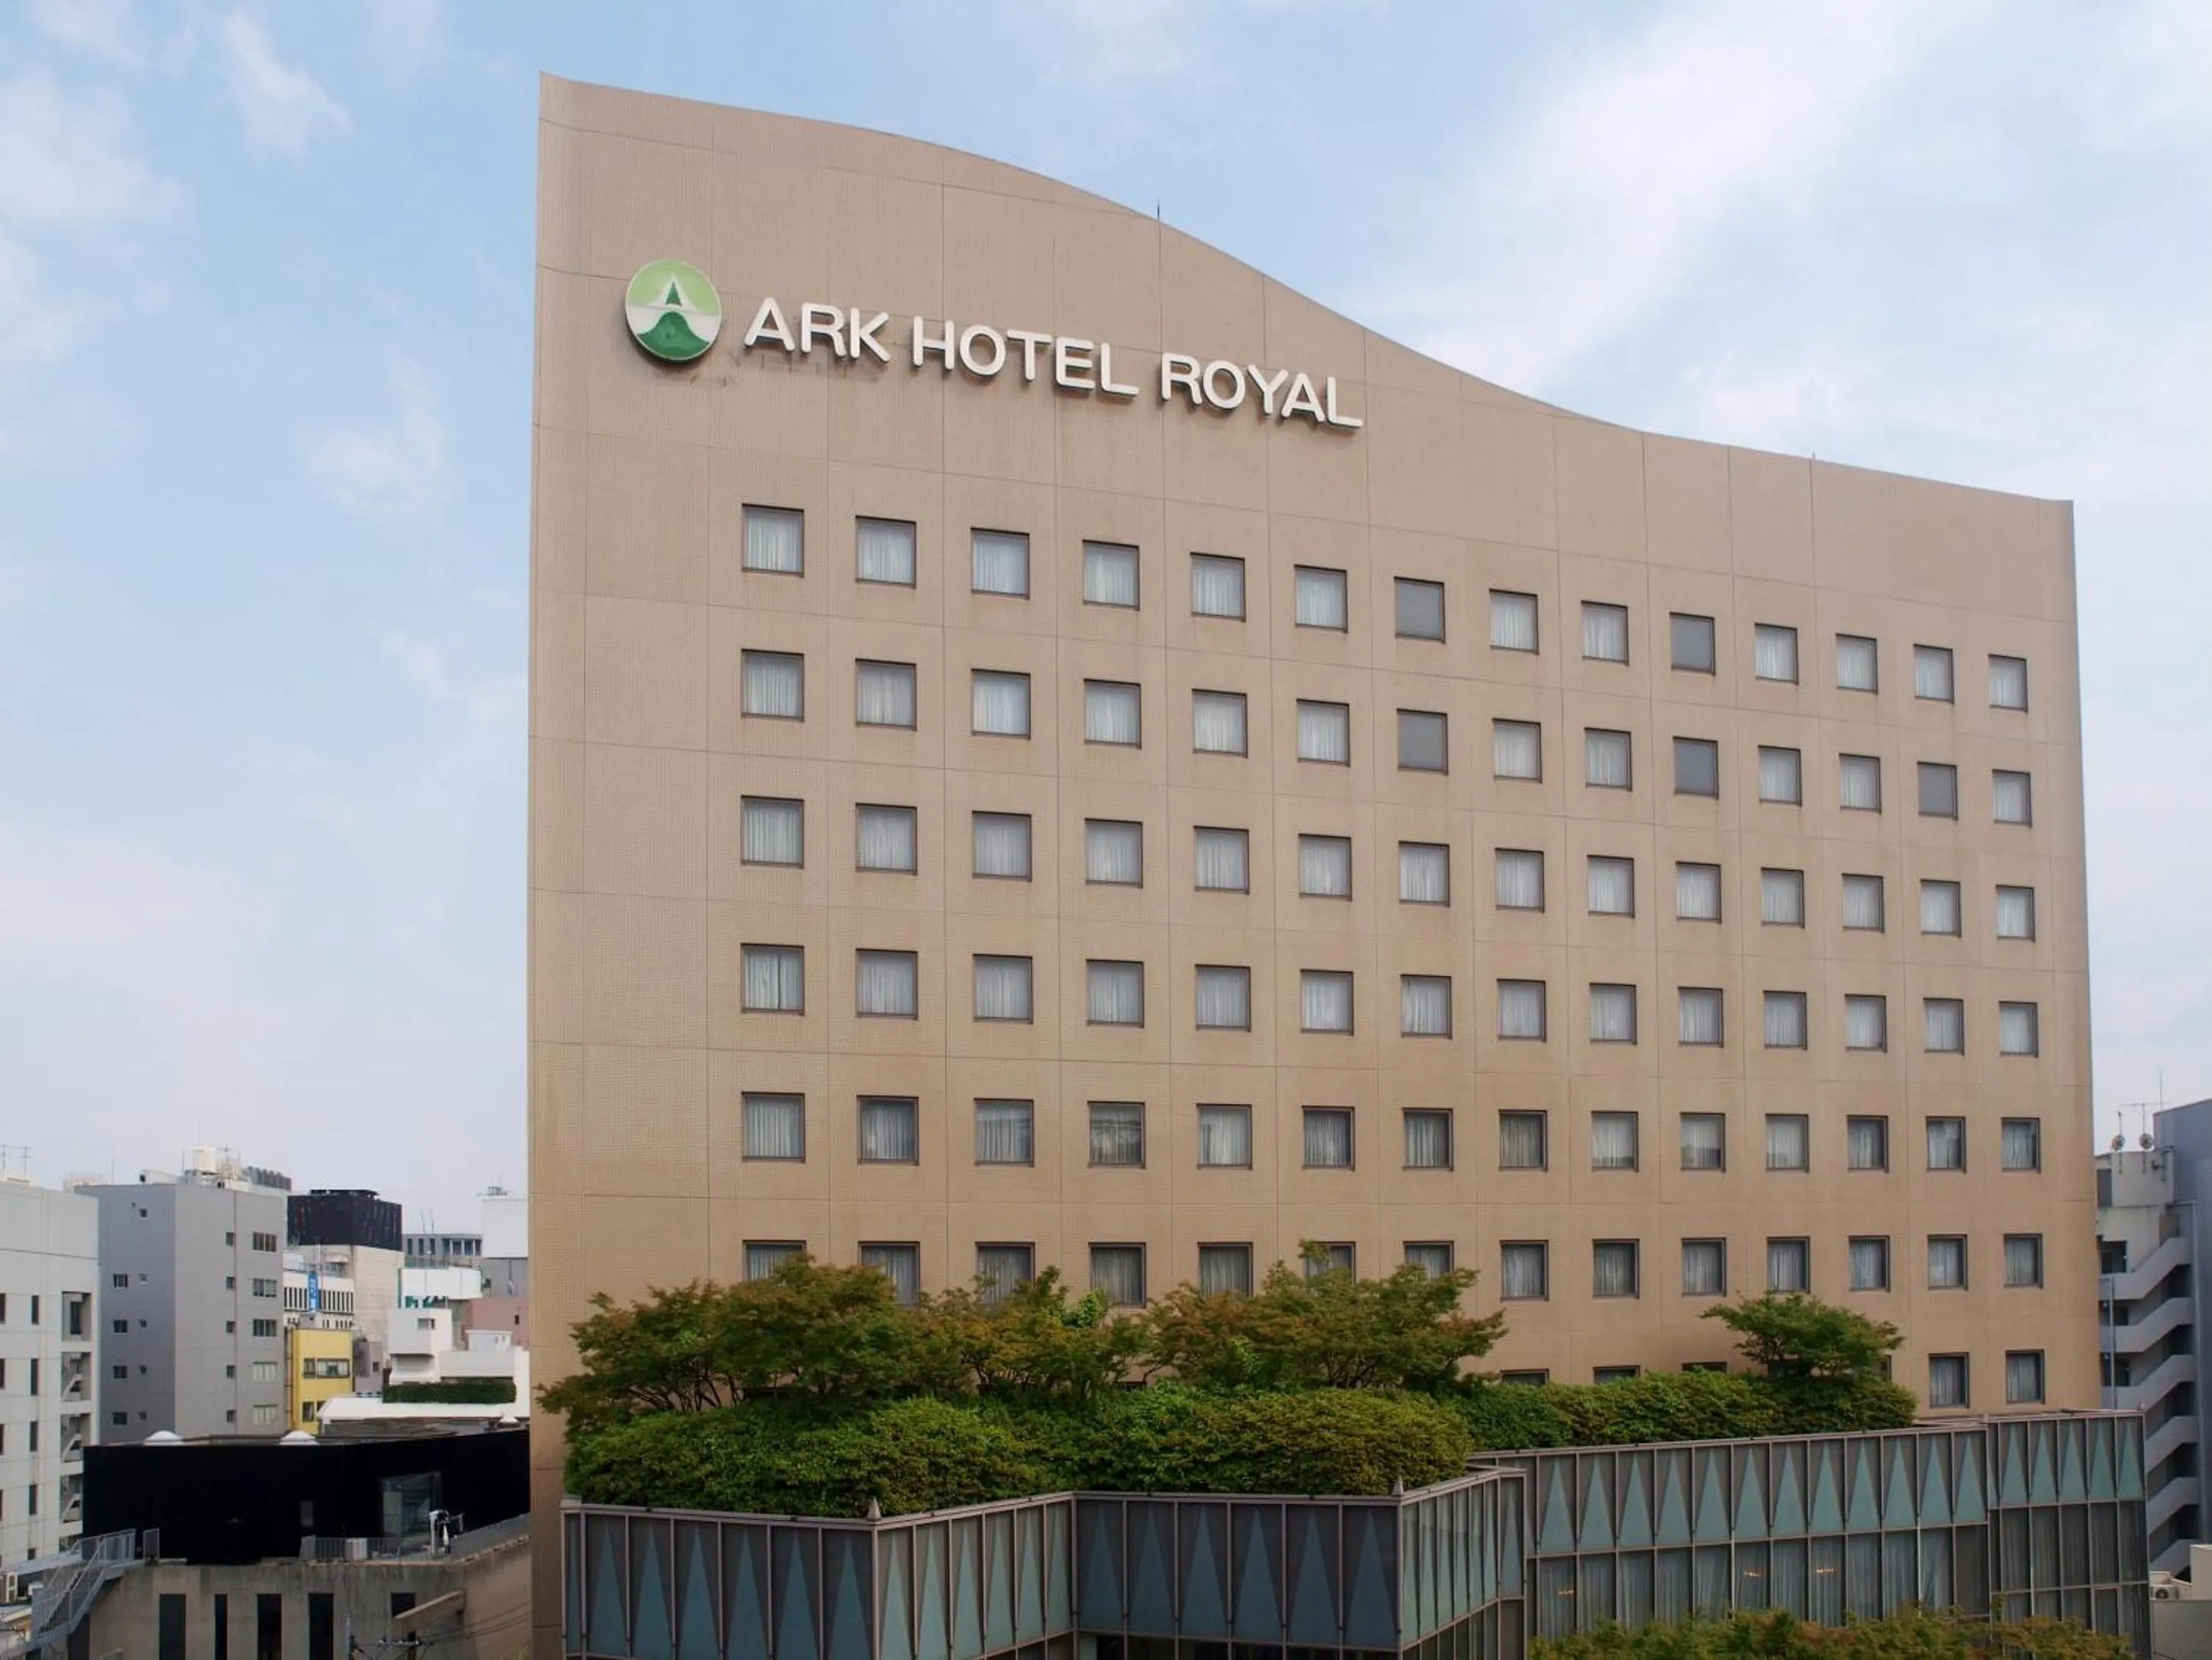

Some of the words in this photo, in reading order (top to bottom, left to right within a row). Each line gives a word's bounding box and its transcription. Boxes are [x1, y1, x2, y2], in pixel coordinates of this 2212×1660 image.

[744, 297, 891, 362] ARK
[913, 315, 1140, 396] HOTEL
[1161, 352, 1364, 428] ROYAL
